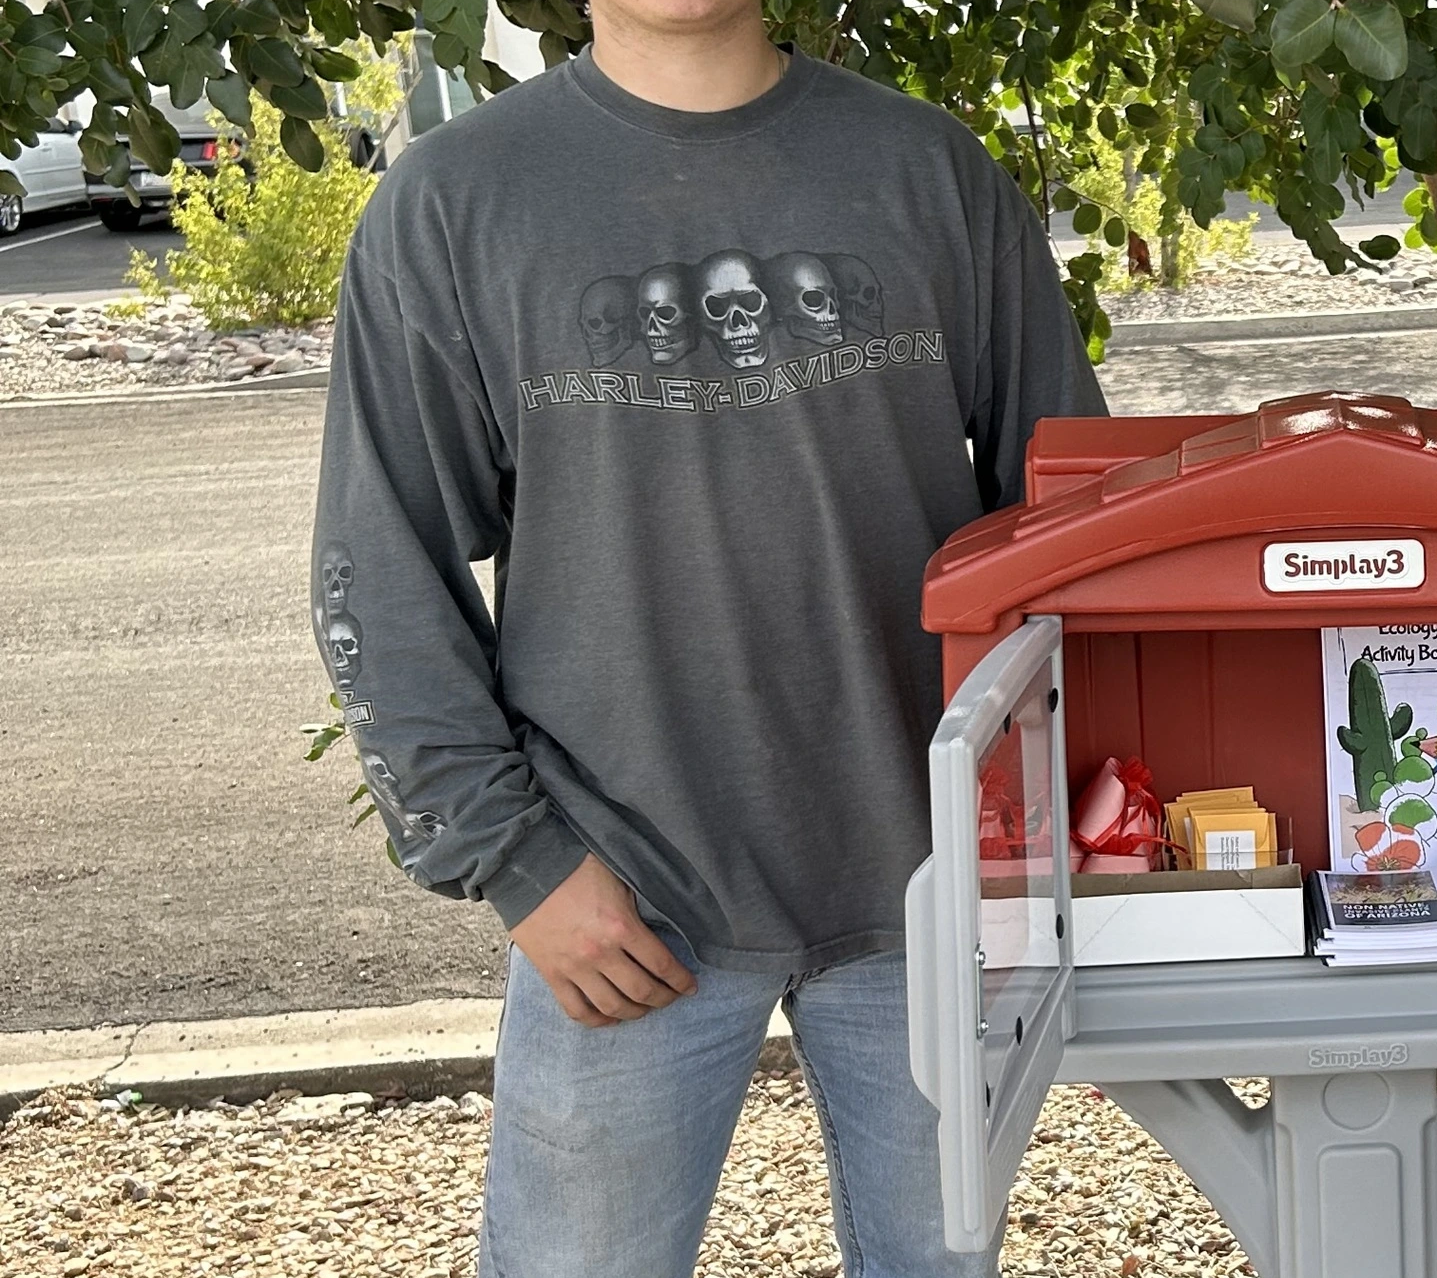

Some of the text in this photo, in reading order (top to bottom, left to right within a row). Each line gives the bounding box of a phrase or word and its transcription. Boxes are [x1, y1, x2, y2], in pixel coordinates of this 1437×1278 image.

[520, 331, 944, 412] HARLEY-DAVIDSON
[1284, 550, 1404, 579] Simplay3
[1361, 645, 1414, 666] Activity
[1366, 910, 1431, 919] ARIZONA
[1309, 1043, 1408, 1068] Simplay3
